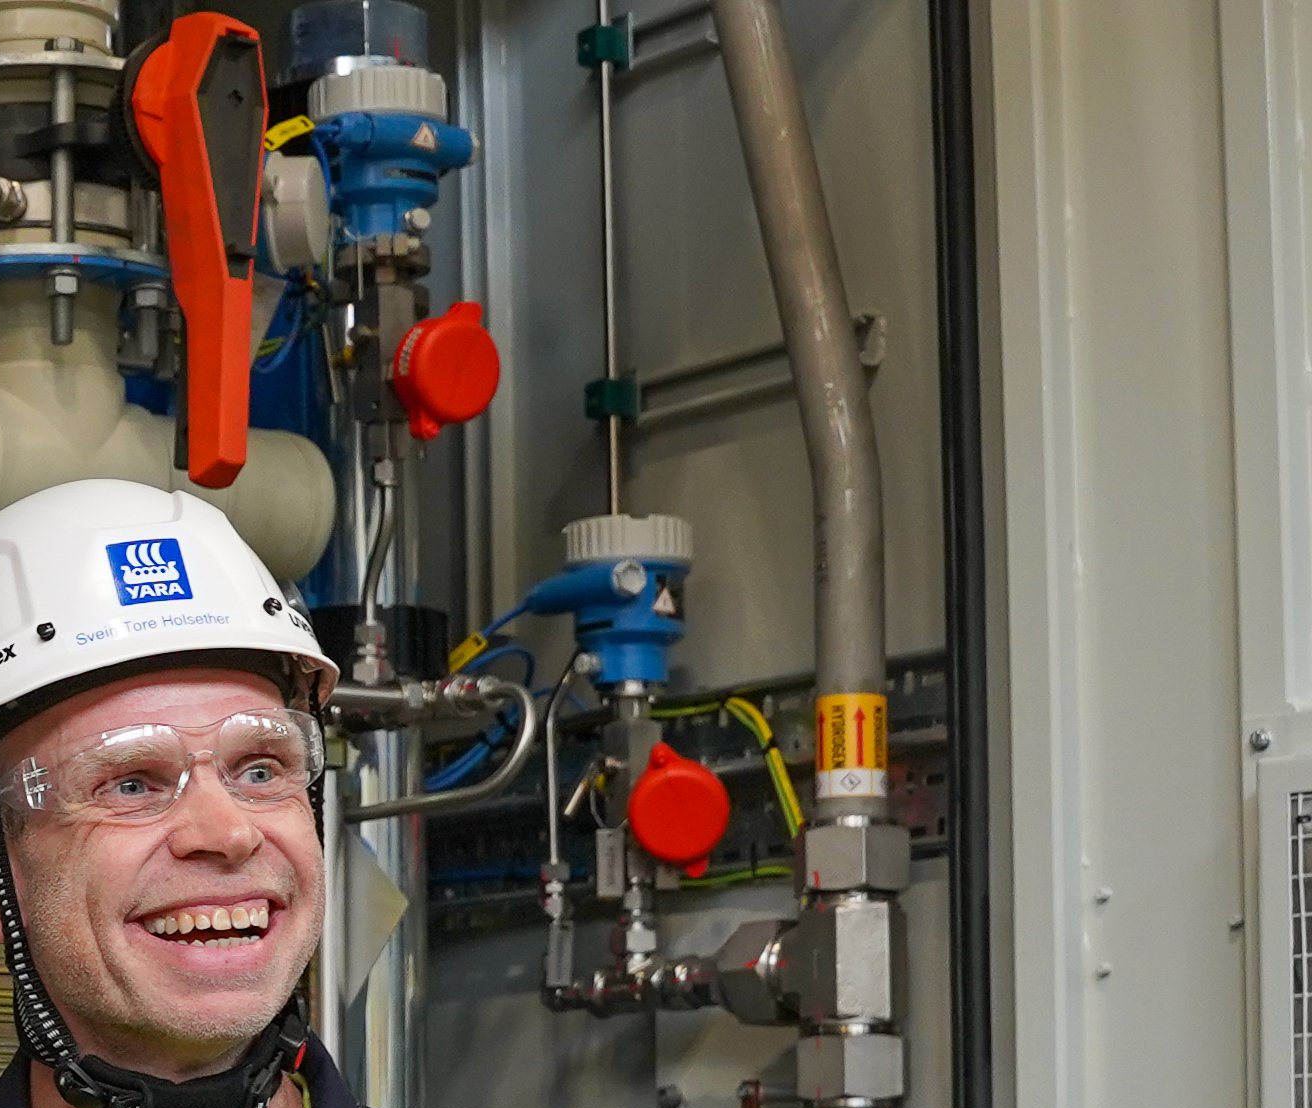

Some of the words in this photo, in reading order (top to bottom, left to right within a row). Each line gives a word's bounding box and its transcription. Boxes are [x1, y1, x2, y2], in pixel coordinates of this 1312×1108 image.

[126, 582, 185, 600] YARA
[75, 626, 118, 646] Svein
[124, 620, 159, 633] Tore
[162, 612, 231, 629] Holsether
